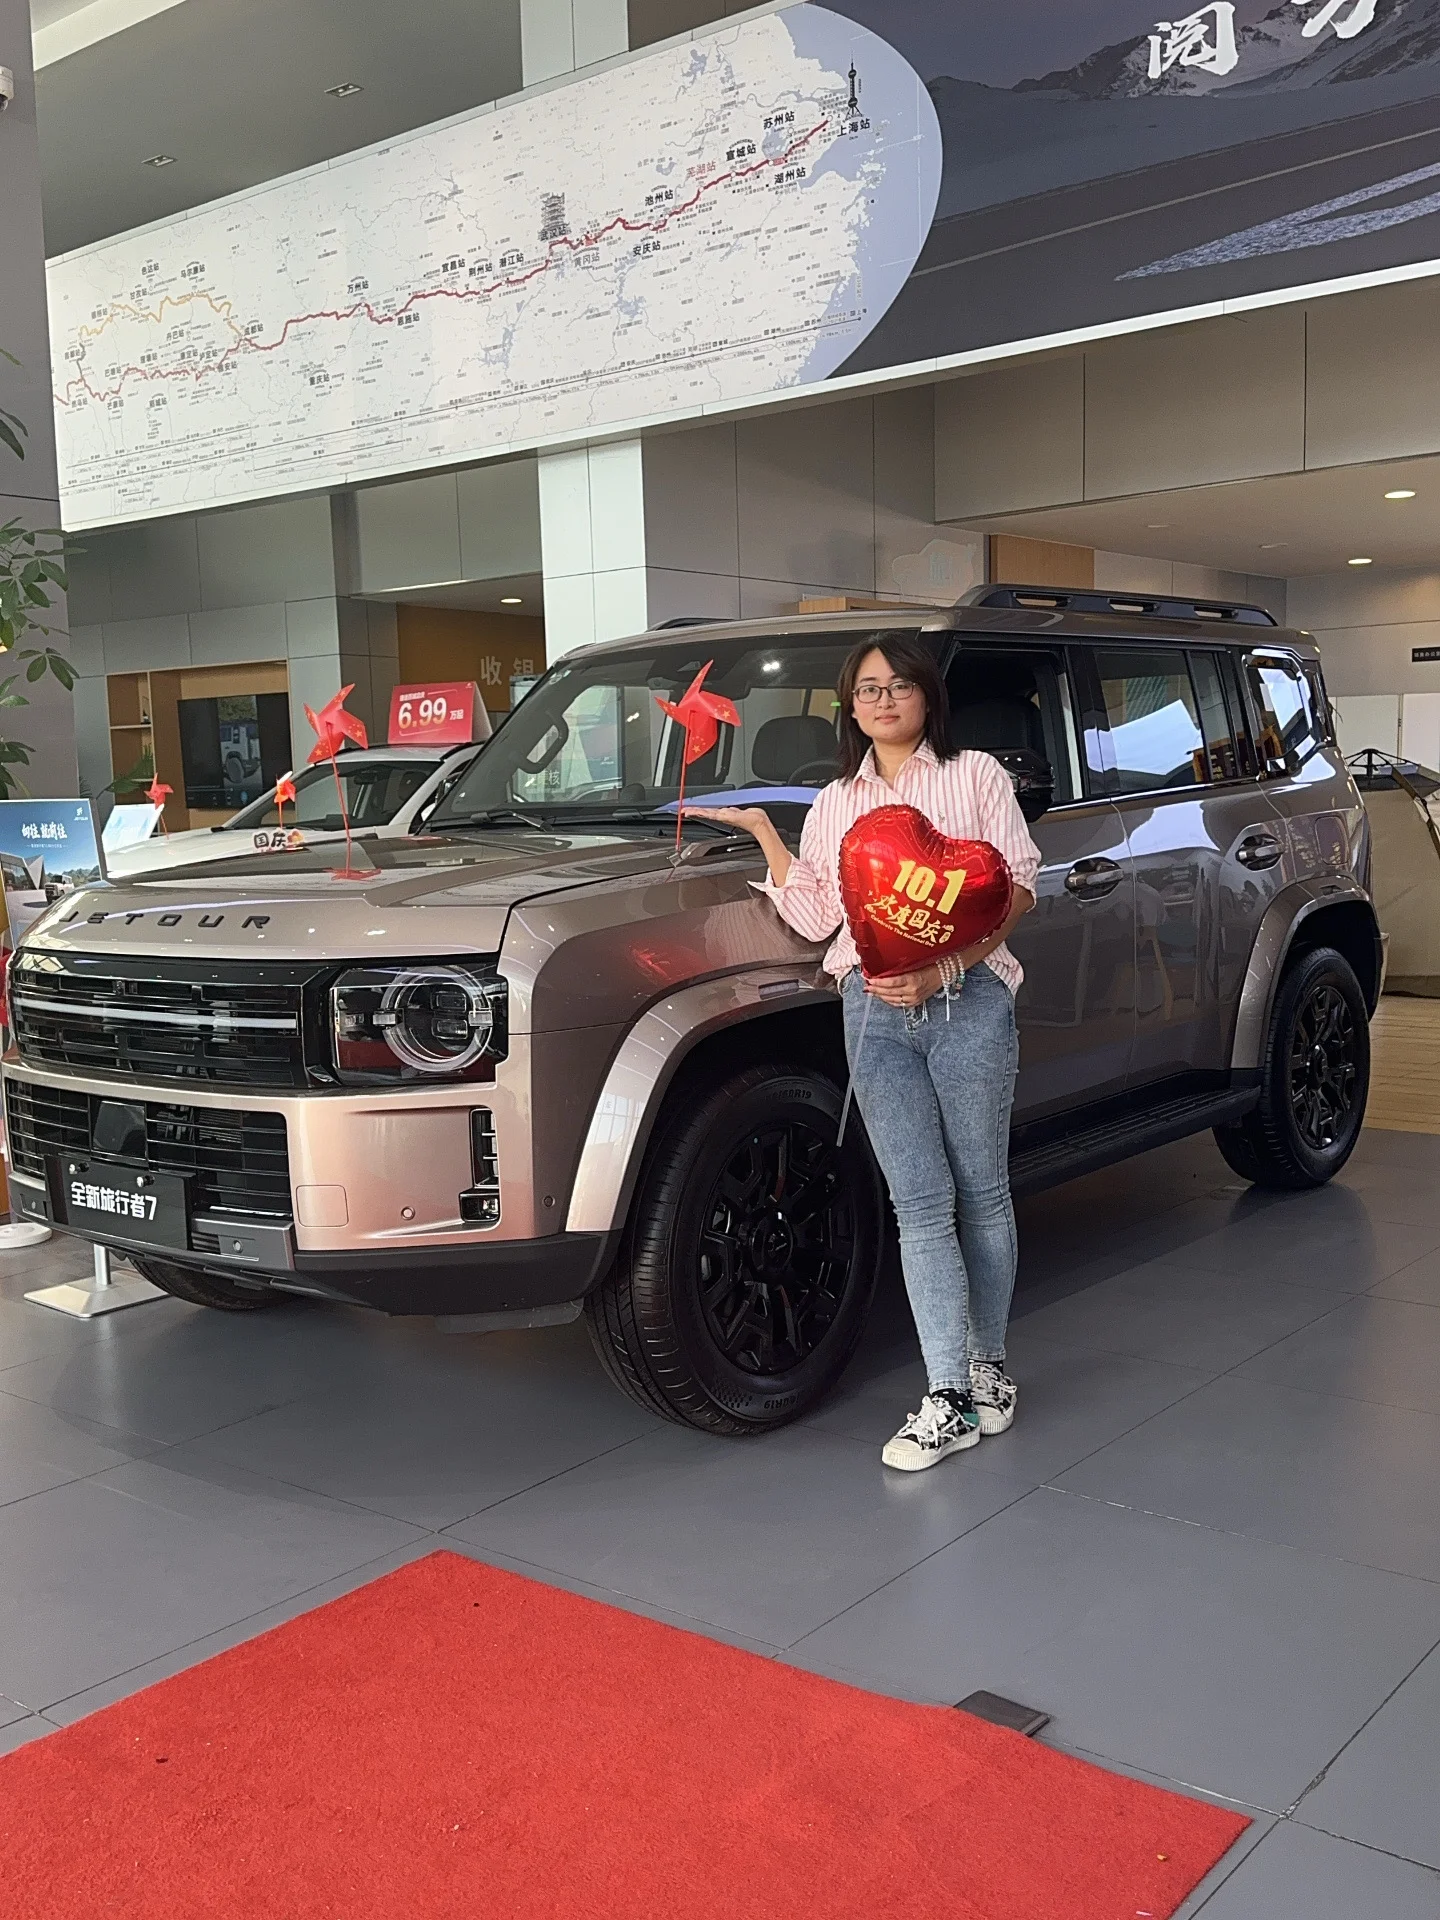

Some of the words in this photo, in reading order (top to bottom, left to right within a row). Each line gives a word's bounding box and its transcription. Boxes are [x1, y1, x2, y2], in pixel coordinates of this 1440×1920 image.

[763, 111, 795, 130] 苏州站
[837, 118, 871, 138] 上海站
[726, 143, 757, 162] 宣城站
[686, 160, 716, 177] 芜湖站
[774, 167, 806, 186] 湖州站
[644, 189, 674, 207] 池州站
[540, 225, 567, 242] 武汉站
[633, 240, 661, 257] 安庆站
[442, 258, 466, 273] 宜昌站
[499, 253, 524, 268] 潜江站
[574, 252, 600, 267] 黄冈站
[468, 262, 493, 277] 荆州站
[347, 279, 370, 294] 万州站
[397, 312, 420, 327] 恩施站
[309, 373, 331, 386] 重庆站
[399, 697, 447, 729] 6.99
[449, 709, 464, 721] 万起
[254, 832, 287, 849] 国庆
[892, 860, 967, 915] 10.1
[59, 911, 271, 929] JETOUR
[864, 893, 941, 944] 欢度国庆
[870, 914, 894, 931] Celebrate
[894, 927, 903, 936] The
[903, 930, 925, 944] National
[70, 1181, 158, 1221] 全新旅行者7
